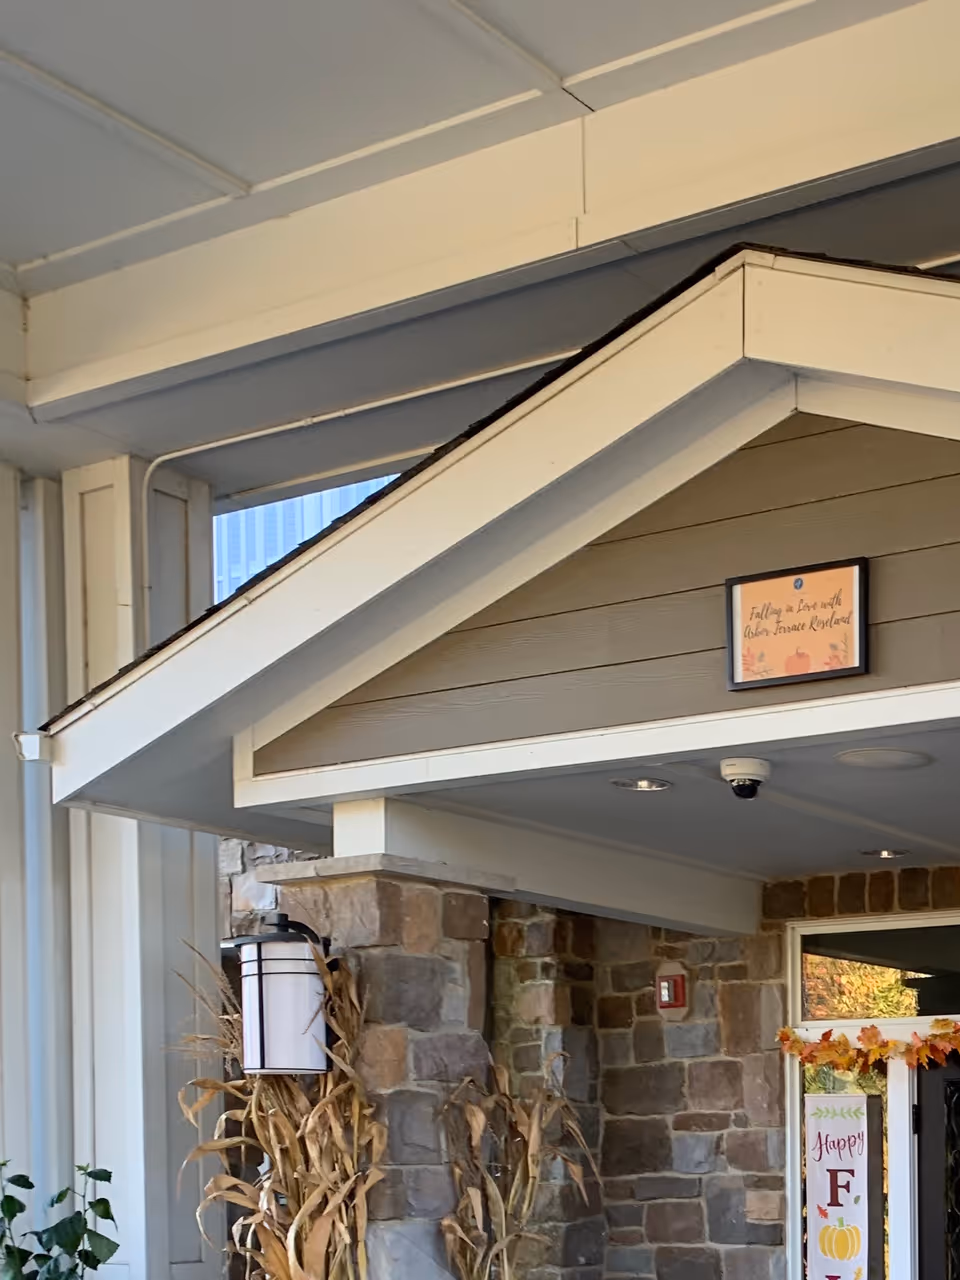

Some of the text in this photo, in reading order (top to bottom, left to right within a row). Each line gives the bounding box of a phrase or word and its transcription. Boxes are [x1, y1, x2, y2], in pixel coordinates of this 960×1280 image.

[749, 601, 782, 622] Falling
[785, 604, 794, 613] in
[796, 598, 817, 613] Love
[820, 588, 842, 609] with
[743, 610, 853, 640] Arbor Terrace Roseland
[811, 1131, 864, 1162] Happy
